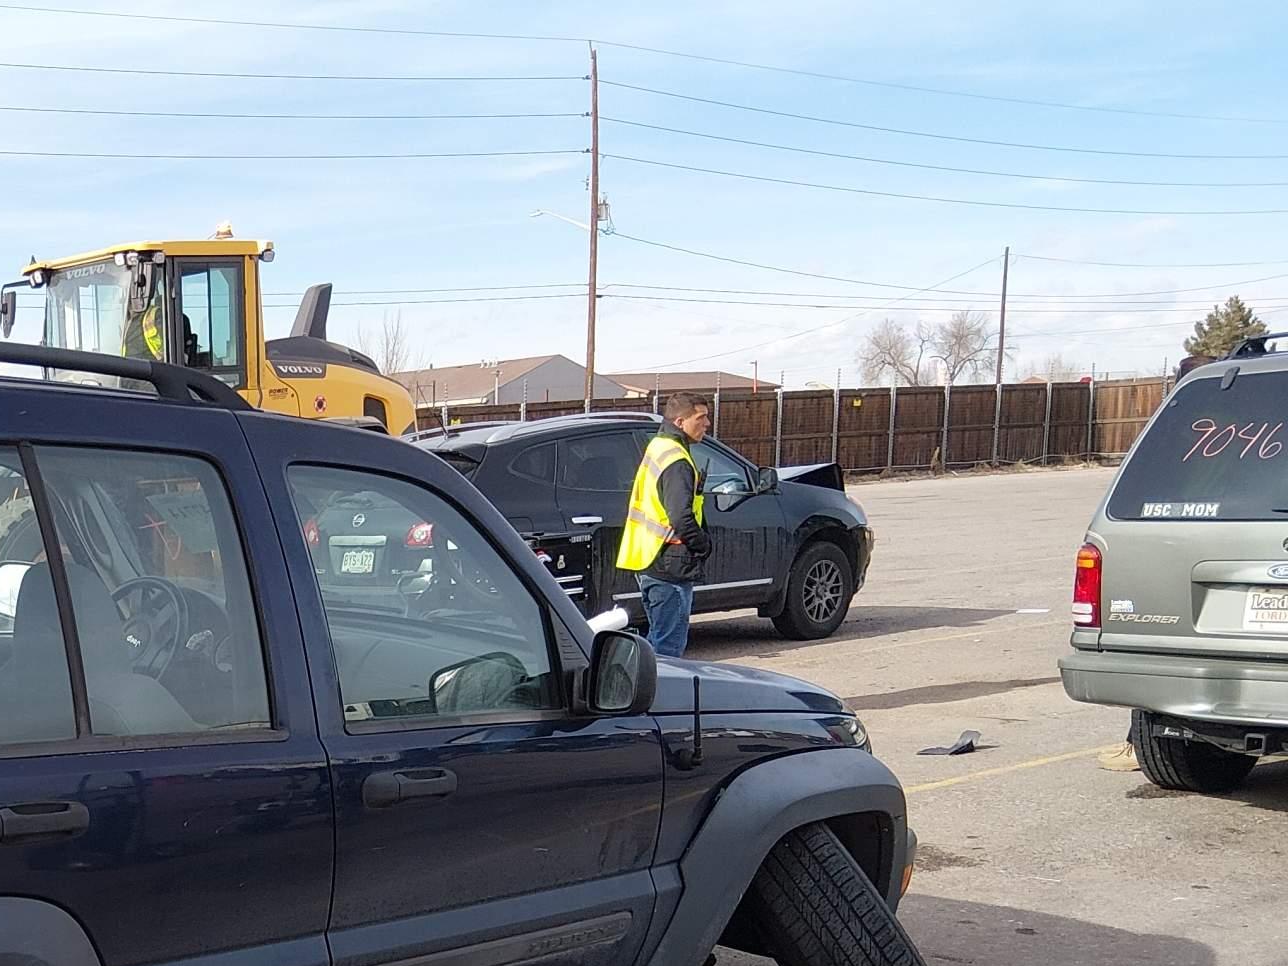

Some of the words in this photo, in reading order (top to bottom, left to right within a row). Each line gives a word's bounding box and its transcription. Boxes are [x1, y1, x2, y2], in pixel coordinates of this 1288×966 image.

[66, 263, 106, 280] VOLVO
[277, 365, 323, 374] VOLVO
[1182, 418, 1283, 462] 9046
[1143, 503, 1172, 517] USC
[1181, 503, 1220, 517] MOM
[1108, 613, 1180, 625] EXPLORER
[1255, 611, 1287, 621] FORD
